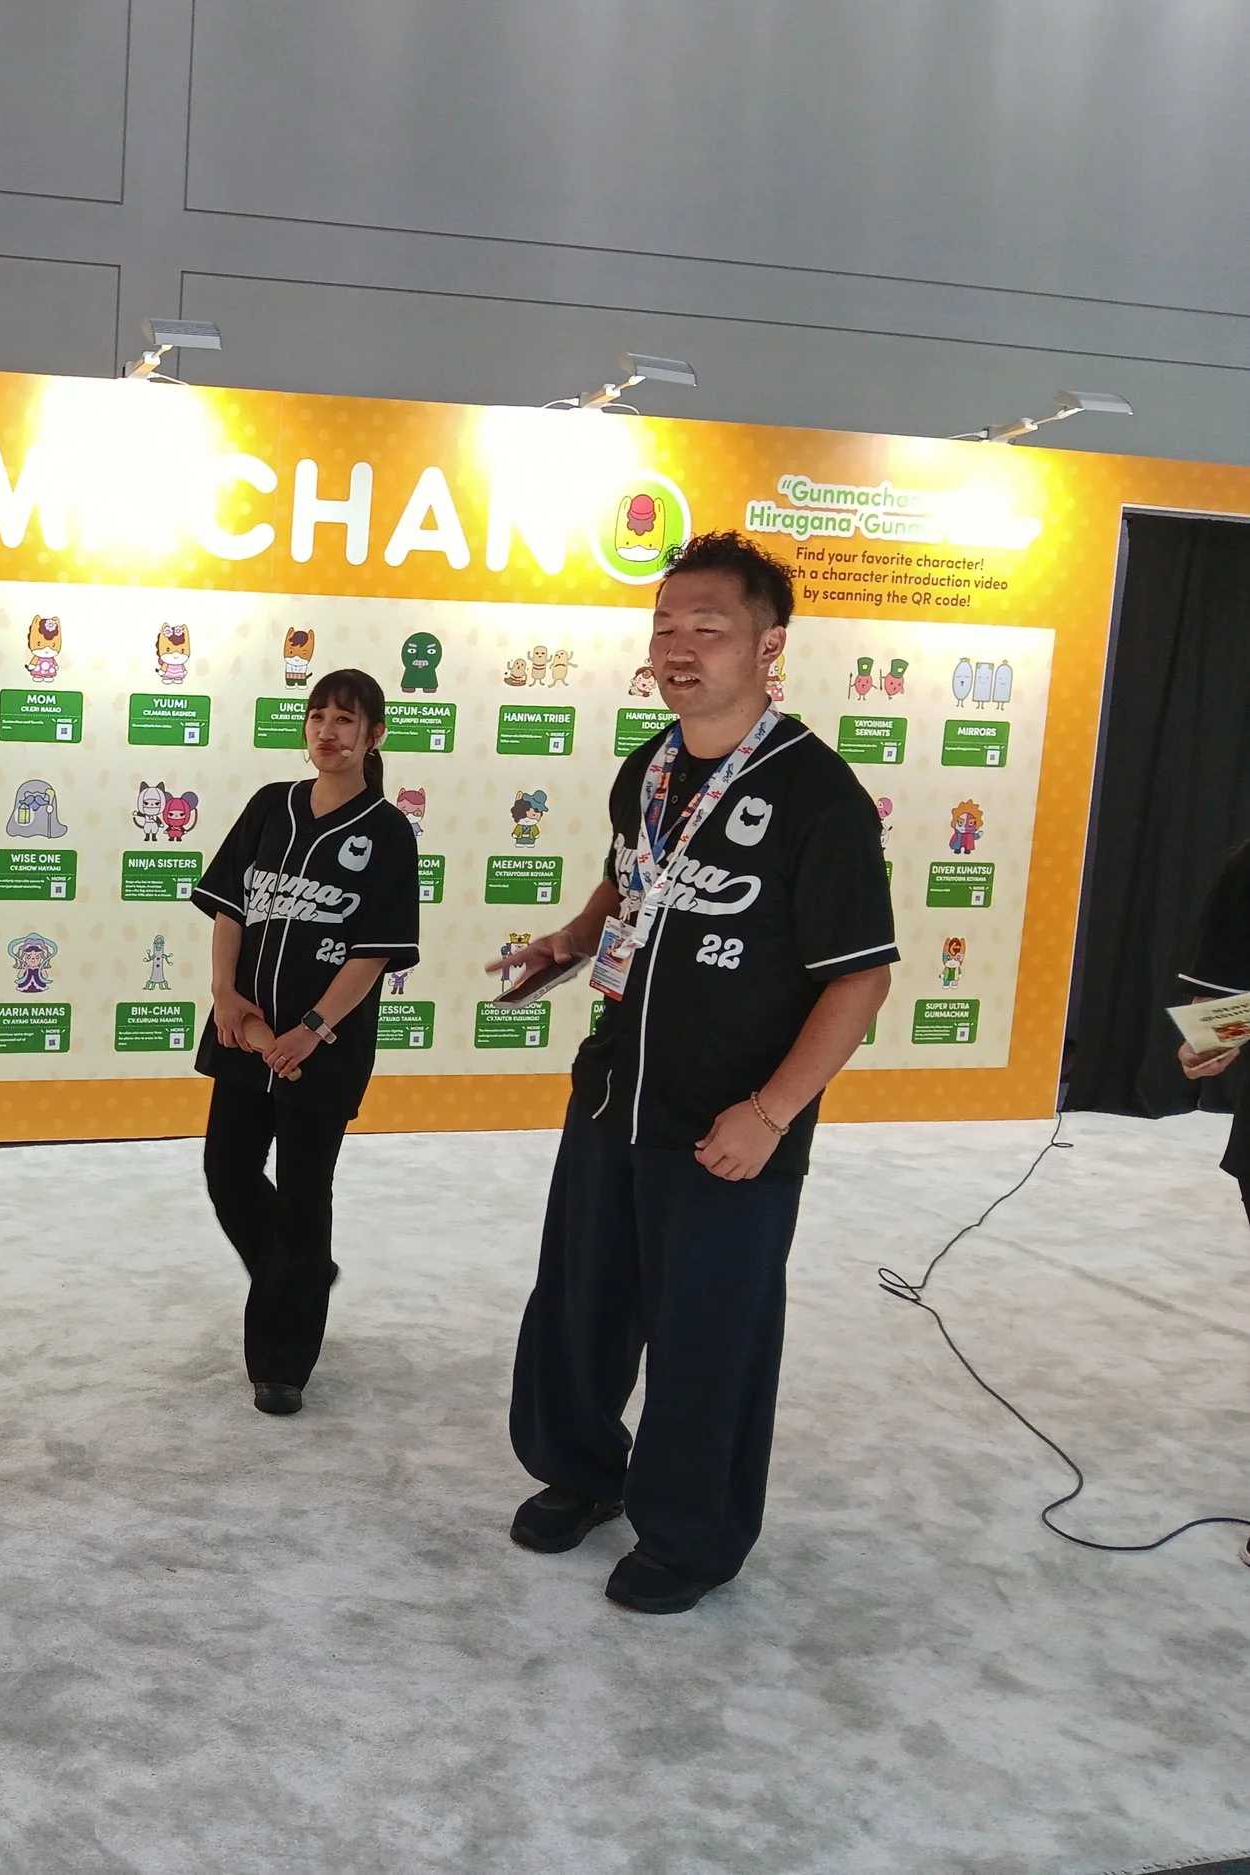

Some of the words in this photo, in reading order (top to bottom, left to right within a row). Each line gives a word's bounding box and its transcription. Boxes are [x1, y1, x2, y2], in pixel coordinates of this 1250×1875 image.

[749, 506, 852, 536] Hiragana
[796, 547, 825, 561] Find
[828, 552, 858, 566] your
[861, 551, 913, 567] favorite
[916, 555, 985, 571] character!
[809, 570, 818, 579] a
[822, 567, 888, 585] character
[891, 571, 971, 589] introduction
[974, 575, 1008, 591] video
[803, 585, 819, 603] by
[822, 589, 882, 606] scanning
[887, 591, 907, 605] the
[911, 592, 932, 606] QR
[935, 594, 971, 608] code!
[26, 694, 56, 704] MOM
[153, 699, 188, 708] YUUMI
[279, 702, 308, 713] UNCL
[384, 706, 451, 716] KOFUN-SAMA
[504, 712, 542, 723] HANIWA
[543, 714, 571, 723] TRIBE
[625, 712, 657, 721] HANIWA
[641, 721, 665, 730] IDOLS
[855, 728, 891, 737] SERVANTS
[957, 727, 997, 737] MIRRORS
[11, 853, 37, 863] WISE
[38, 854, 61, 863] ONE
[128, 858, 156, 871] NINJA
[157, 859, 197, 868] SISTERS
[535, 861, 556, 869] DAD
[932, 866, 955, 874] DIVER
[316, 937, 346, 965] 22
[696, 933, 744, 969] 22
[131, 1006, 181, 1016] BIN-CHAN
[379, 1006, 415, 1015] JESSICA
[925, 1002, 947, 1010] SUPER
[31, 1007, 65, 1017] NANAS
